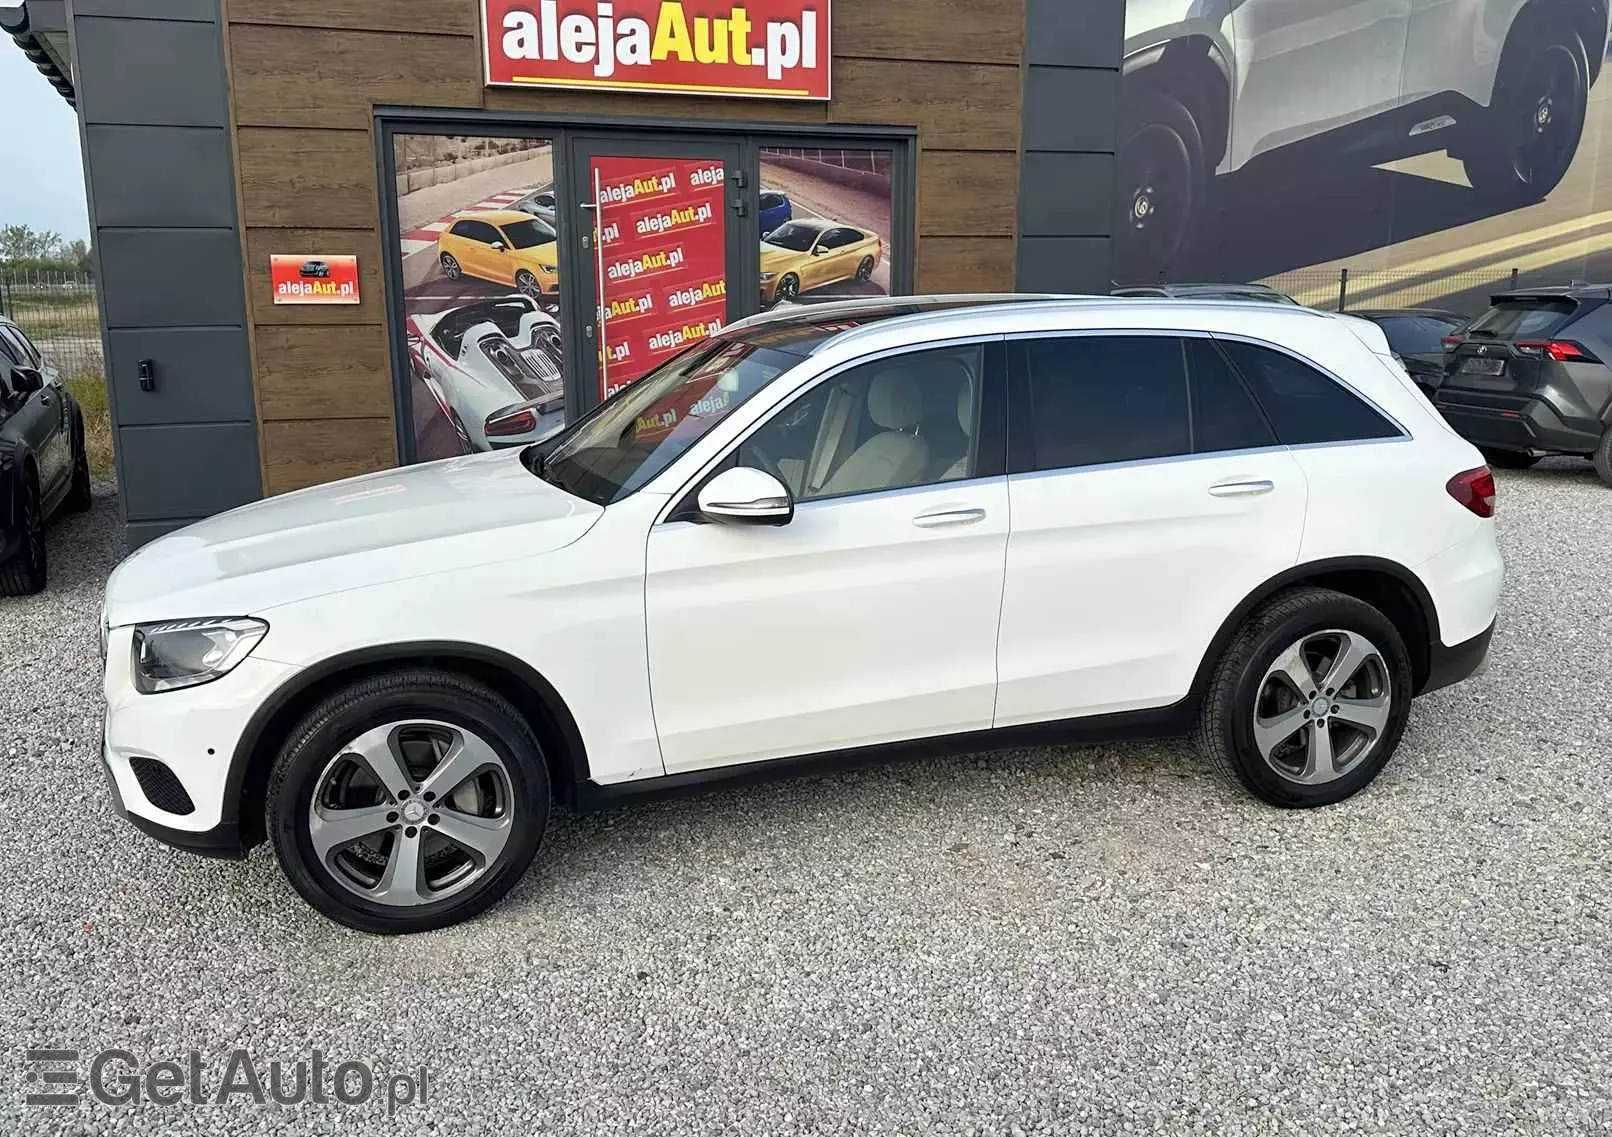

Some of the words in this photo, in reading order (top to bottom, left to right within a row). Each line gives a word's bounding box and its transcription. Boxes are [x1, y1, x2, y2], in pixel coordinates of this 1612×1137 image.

[502, 0, 817, 80] alejaAut.pl
[600, 172, 676, 203] alejaAut.pl
[636, 203, 712, 233] alejaAut.pl
[607, 247, 684, 279] alejaAut.pl
[278, 281, 354, 297] alejaAut.pl
[648, 318, 722, 350] alejaAut.pl
